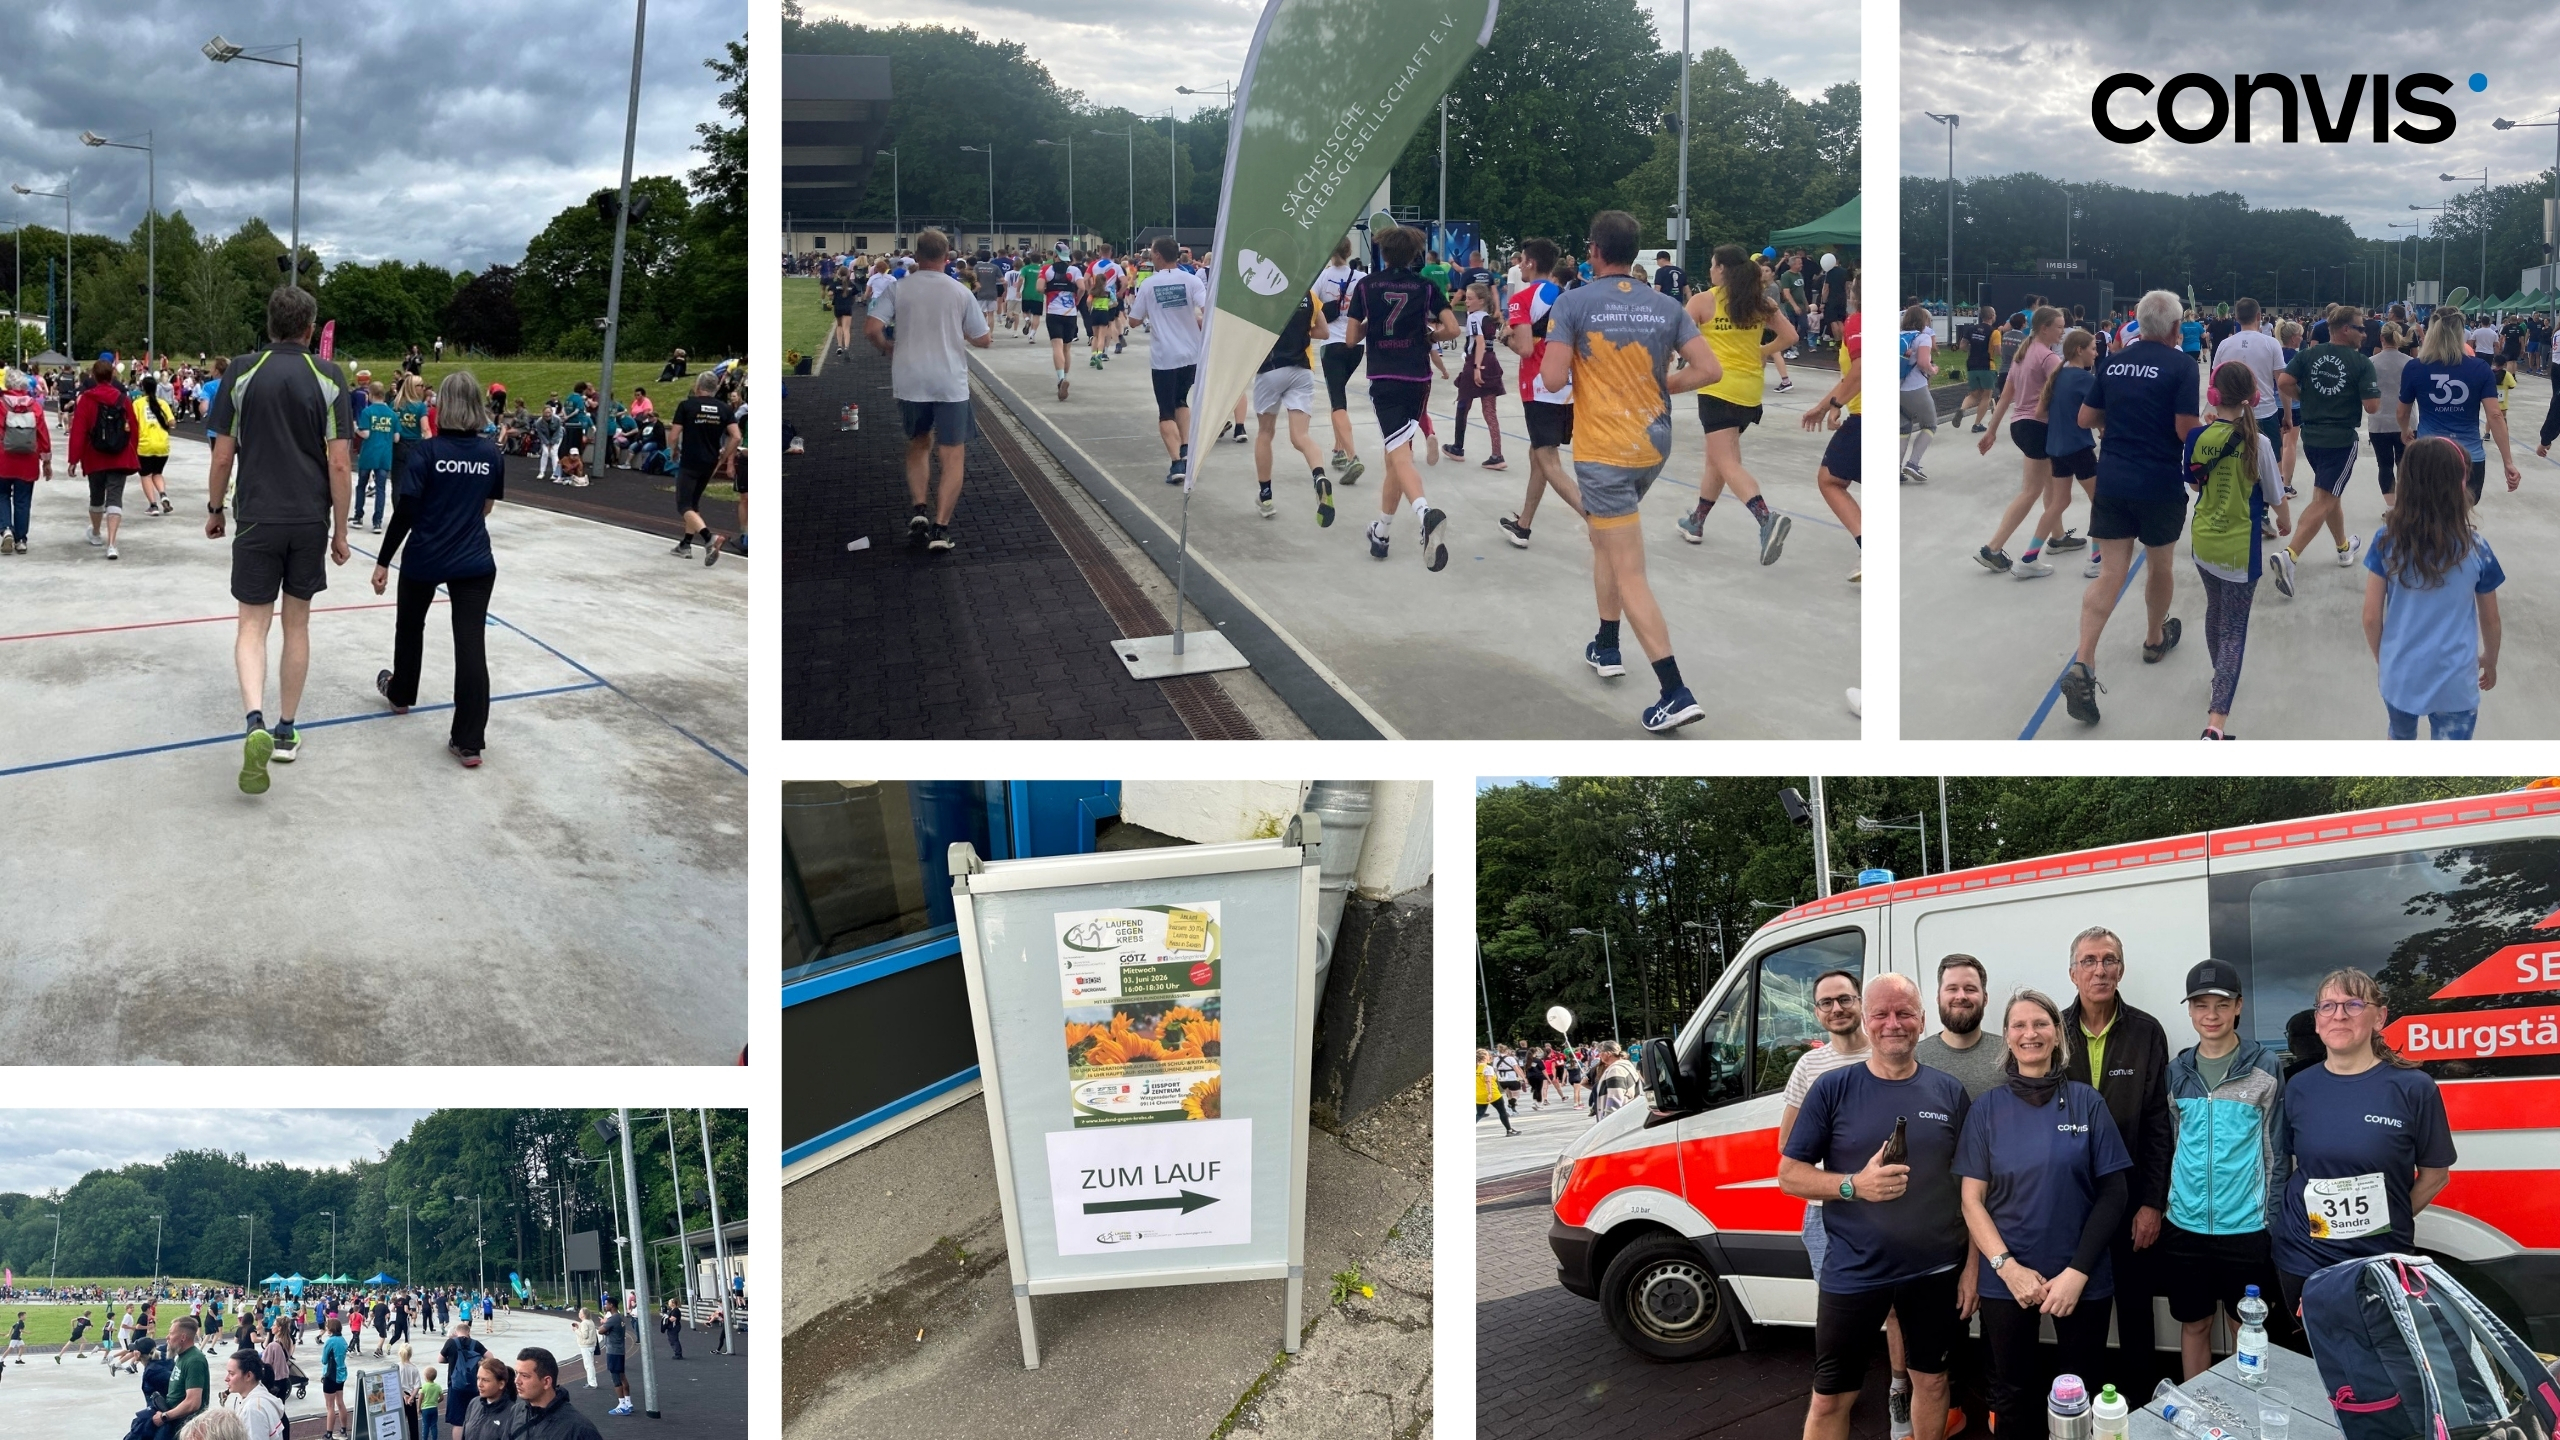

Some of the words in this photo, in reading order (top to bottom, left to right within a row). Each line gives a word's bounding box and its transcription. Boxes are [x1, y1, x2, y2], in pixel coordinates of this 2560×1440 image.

[1298, 43, 1432, 230] KREBSGESELLSCHAFT
[1429, 13, 1457, 45] E.V.
[1282, 101, 1366, 217] SÄCHSISCHE
[1383, 291, 1408, 336] 7
[1591, 313, 1627, 322] SCHRITT
[1630, 314, 1665, 323] VORAUS
[2428, 373, 2470, 405] 30
[1106, 919, 1143, 928] LAUFEND
[1116, 928, 1143, 936] GEGEN
[1117, 936, 1144, 944] KREBS
[1120, 954, 1146, 962] GÖTZ
[1123, 966, 1156, 974] Mittwoch
[1135, 975, 1149, 984] Juni
[1124, 983, 1164, 993] 16:00-18:30
[1081, 1166, 1143, 1189] ZUM
[1154, 1161, 1221, 1184] LAUF
[2323, 1195, 2369, 1217] 315
[2330, 1217, 2371, 1229] Sandra
